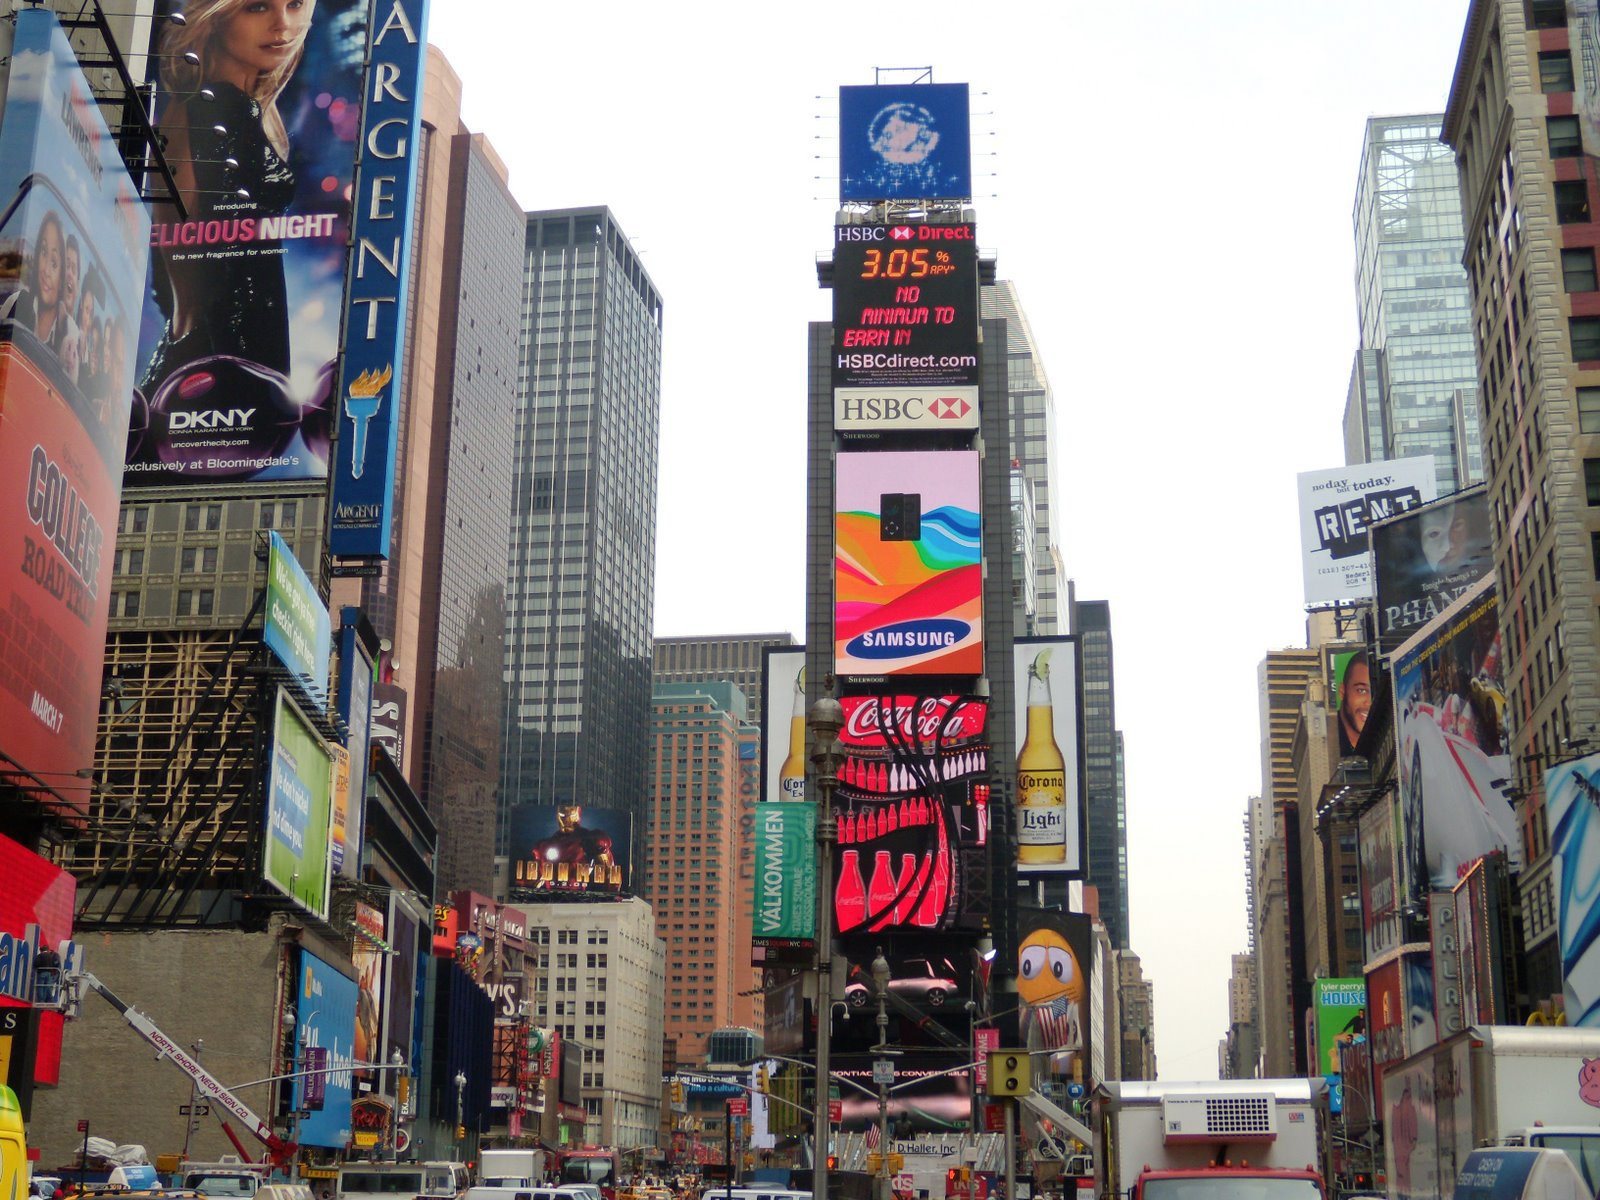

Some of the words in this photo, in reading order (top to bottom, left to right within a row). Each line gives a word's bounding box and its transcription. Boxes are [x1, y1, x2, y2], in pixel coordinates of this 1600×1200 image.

[353, 0, 417, 340] ARGENT
[213, 202, 257, 211] introducing
[259, 213, 338, 241] NIGHT
[839, 227, 885, 241] HSBC
[172, 253, 186, 261] the
[206, 250, 245, 261] fragrance
[247, 249, 259, 257] for
[260, 248, 289, 256] women
[896, 286, 920, 303] NO
[861, 307, 929, 324] MINIMUM
[935, 306, 955, 324] TO
[843, 329, 890, 347] EARN
[894, 329, 911, 346] IN
[838, 354, 976, 368] HSBCdirect.com
[842, 398, 924, 420] HSBC
[169, 408, 256, 429] DKNY
[171, 439, 249, 448] uncoverthecity.com
[190, 460, 203, 469] at
[207, 455, 299, 469] Bloomingdale's
[1325, 479, 1348, 489] day
[1353, 476, 1395, 491] today.
[863, 632, 955, 647] SAMSUNG
[31, 690, 57, 730] MARCH
[57, 712, 64, 734] 7
[1019, 775, 1063, 791] Corona
[1023, 809, 1060, 829] Light
[805, 843, 814, 859] THE
[516, 860, 569, 881] IRON
[576, 863, 622, 884] MAN
[759, 810, 784, 932] VÄLKOMMEN
[1321, 983, 1338, 991] tyler
[976, 1032, 987, 1084] WELCOME
[150, 1031, 176, 1054] NORTH
[174, 1053, 200, 1076] SHORE
[199, 1074, 221, 1094] NEON
[218, 1092, 238, 1109] SIGN
[236, 1107, 249, 1120] CO.
[908, 1144, 938, 1154] Haller,
[940, 1144, 958, 1153] Inc.
